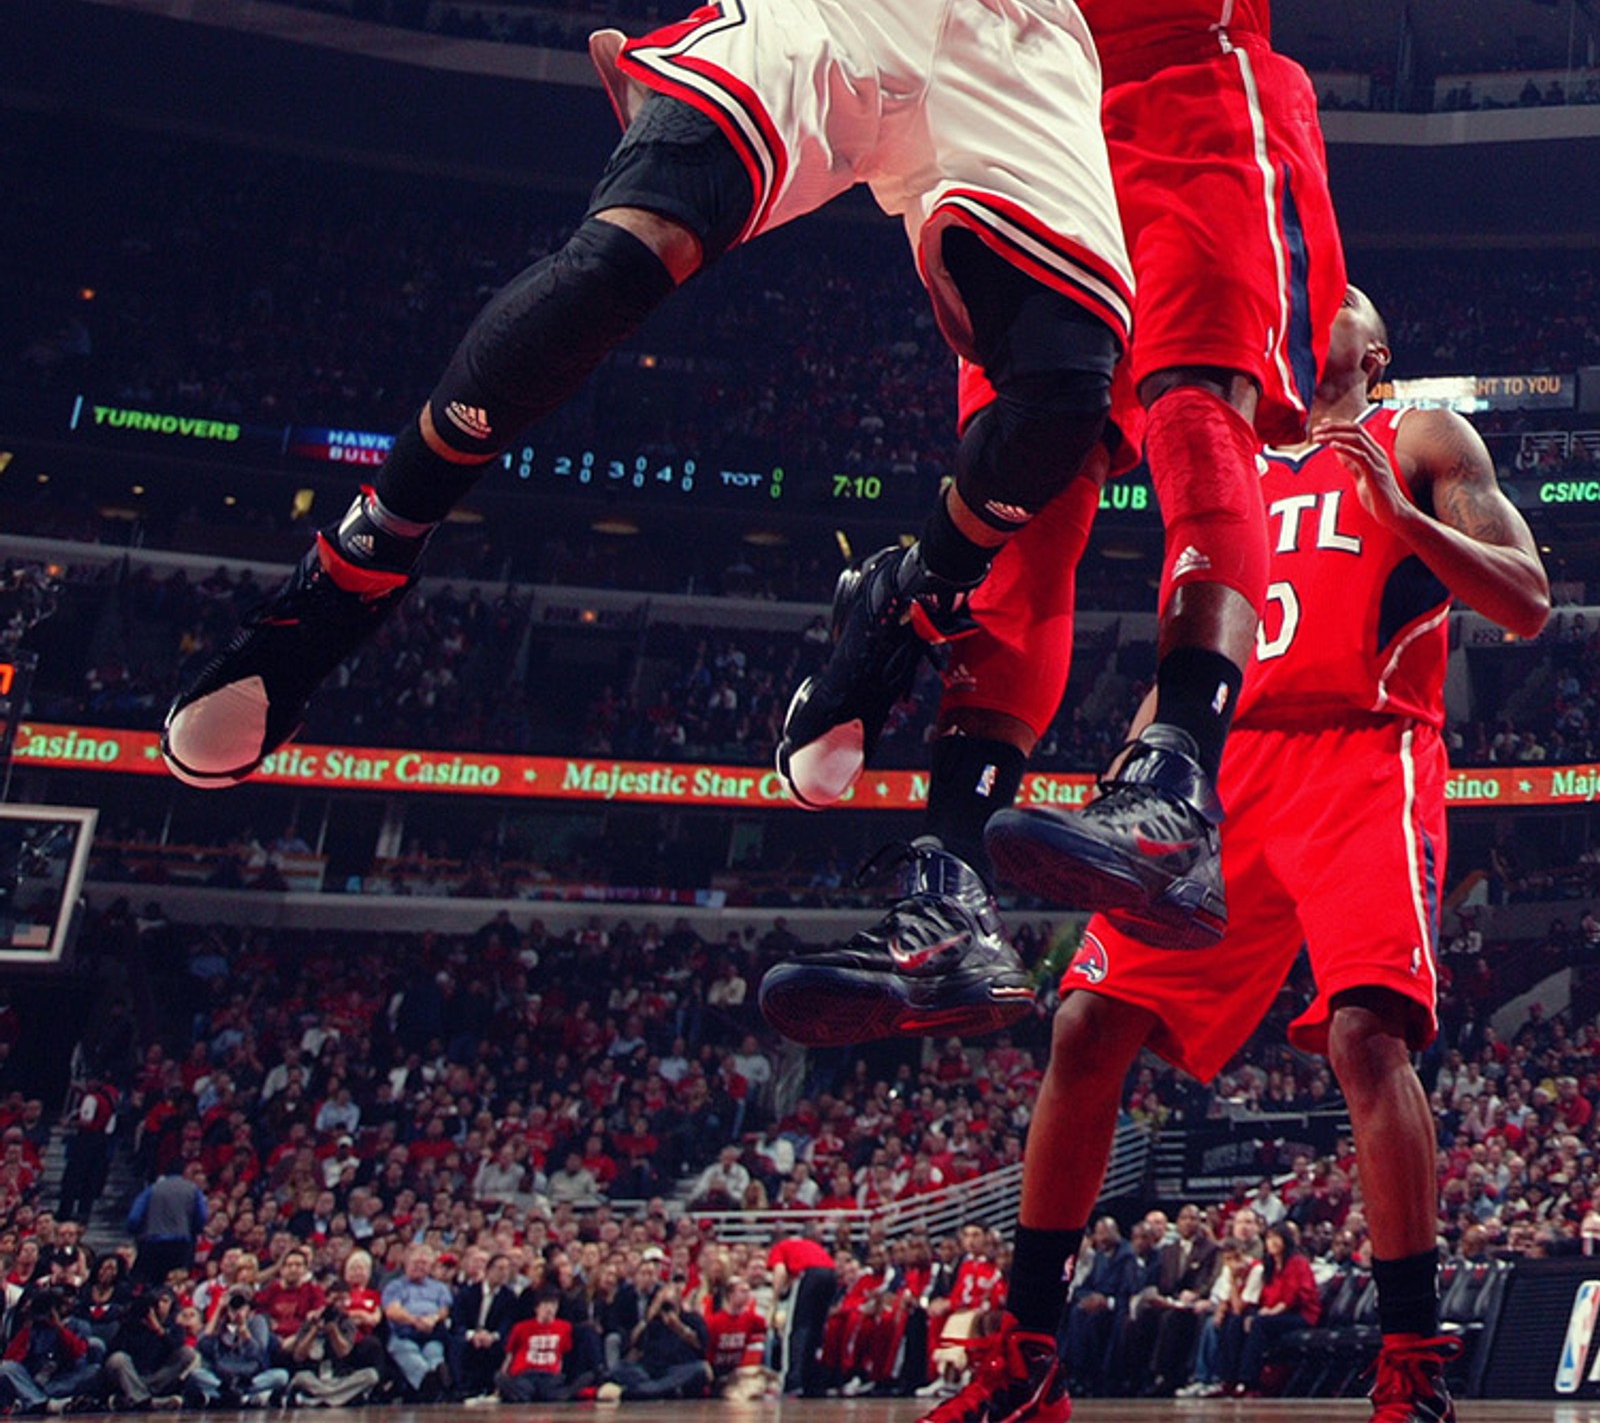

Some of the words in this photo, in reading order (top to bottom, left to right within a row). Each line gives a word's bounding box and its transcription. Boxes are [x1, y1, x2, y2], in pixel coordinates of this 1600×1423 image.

[1503, 378, 1525, 395] TO
[1528, 377, 1561, 394] YOU
[94, 406, 241, 441] TURNOVERS
[326, 431, 392, 450] HAWK
[328, 446, 384, 465] BULL
[502, 452, 512, 470] 1
[555, 457, 572, 475] 2
[608, 461, 625, 478] 3
[656, 465, 672, 482] 4
[720, 471, 762, 486] TOT
[832, 475, 882, 499] 7:10
[1099, 484, 1148, 509] LUB
[1540, 482, 1600, 503] CSNC
[1268, 490, 1362, 555] TL
[260, 749, 317, 777] stic
[322, 749, 389, 781] Star
[394, 753, 501, 787] Casino
[562, 761, 688, 800] Majestic
[692, 768, 754, 799] Star
[1030, 776, 1089, 804] Star
[1444, 773, 1500, 800] sino
